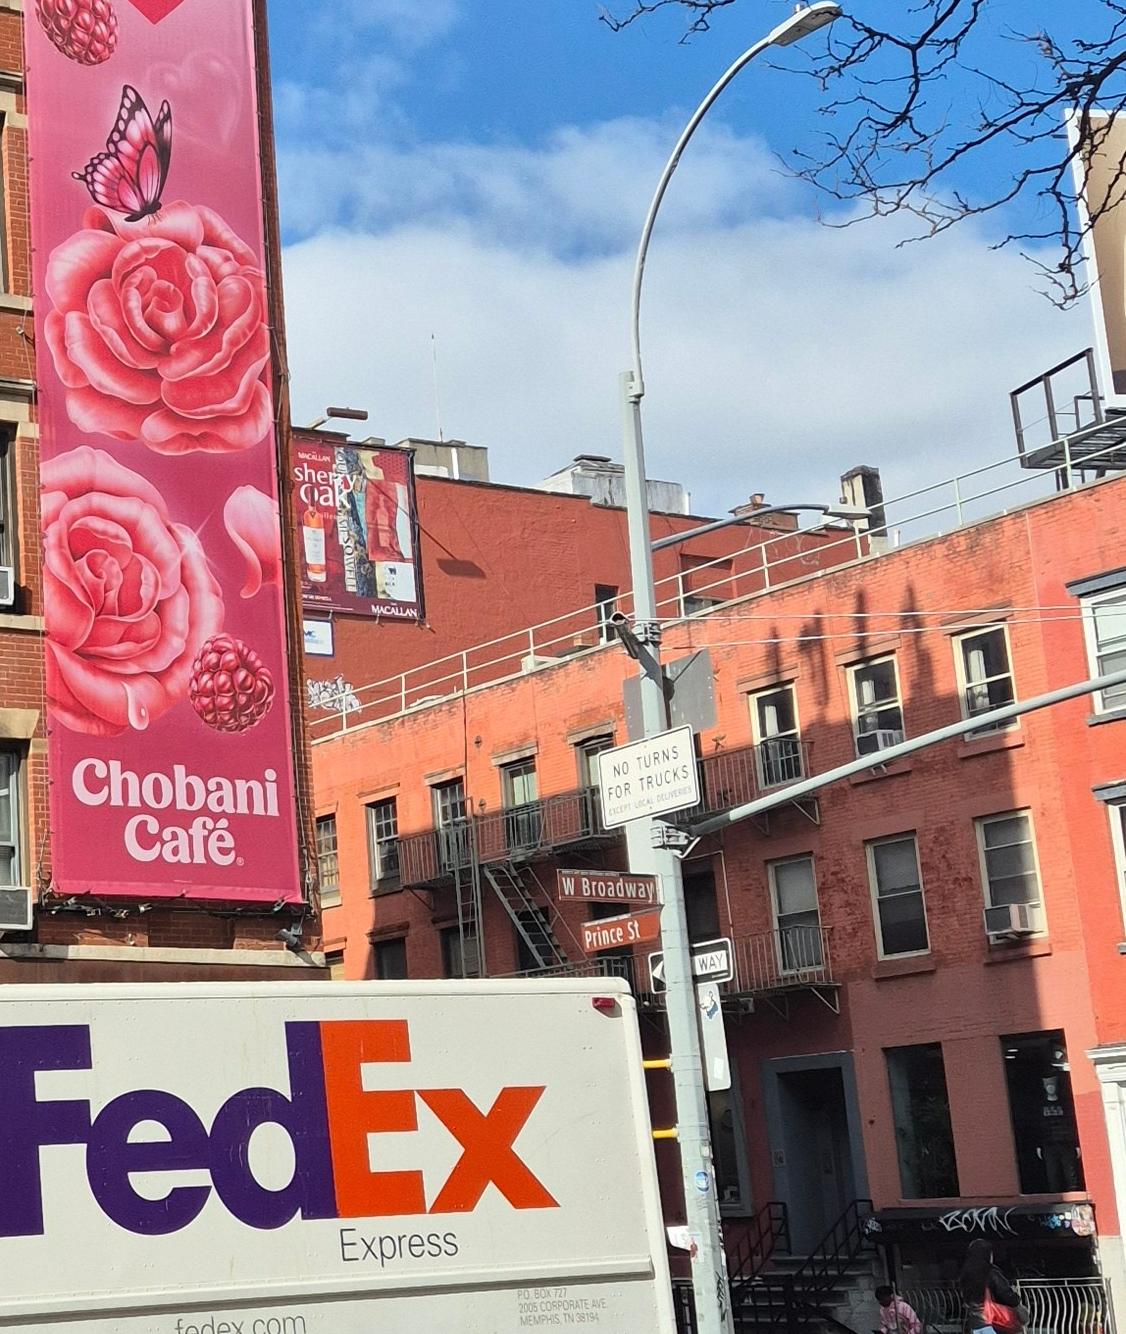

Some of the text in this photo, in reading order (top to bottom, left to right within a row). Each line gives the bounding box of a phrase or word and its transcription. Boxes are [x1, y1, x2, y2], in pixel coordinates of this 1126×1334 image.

[294, 462, 357, 493] sherry
[299, 483, 352, 508] oak
[371, 604, 418, 618] MACALLAN
[613, 746, 679, 778] NO TURNS
[72, 757, 279, 816] Chobani
[608, 765, 689, 801] FOR TRUCKS
[608, 786, 693, 816] EXCEPT LOCAL DELIVERIES
[562, 877, 655, 903] W Broadway
[584, 924, 624, 949] Prince
[627, 920, 641, 941] St
[697, 952, 724, 972] WAY
[340, 1228, 459, 1268] Express
[518, 1302, 538, 1314] 2005
[540, 1299, 590, 1312] CORPORATE
[534, 1288, 552, 1299] BOX
[554, 1287, 568, 1299] 727
[563, 1313, 575, 1323] TN
